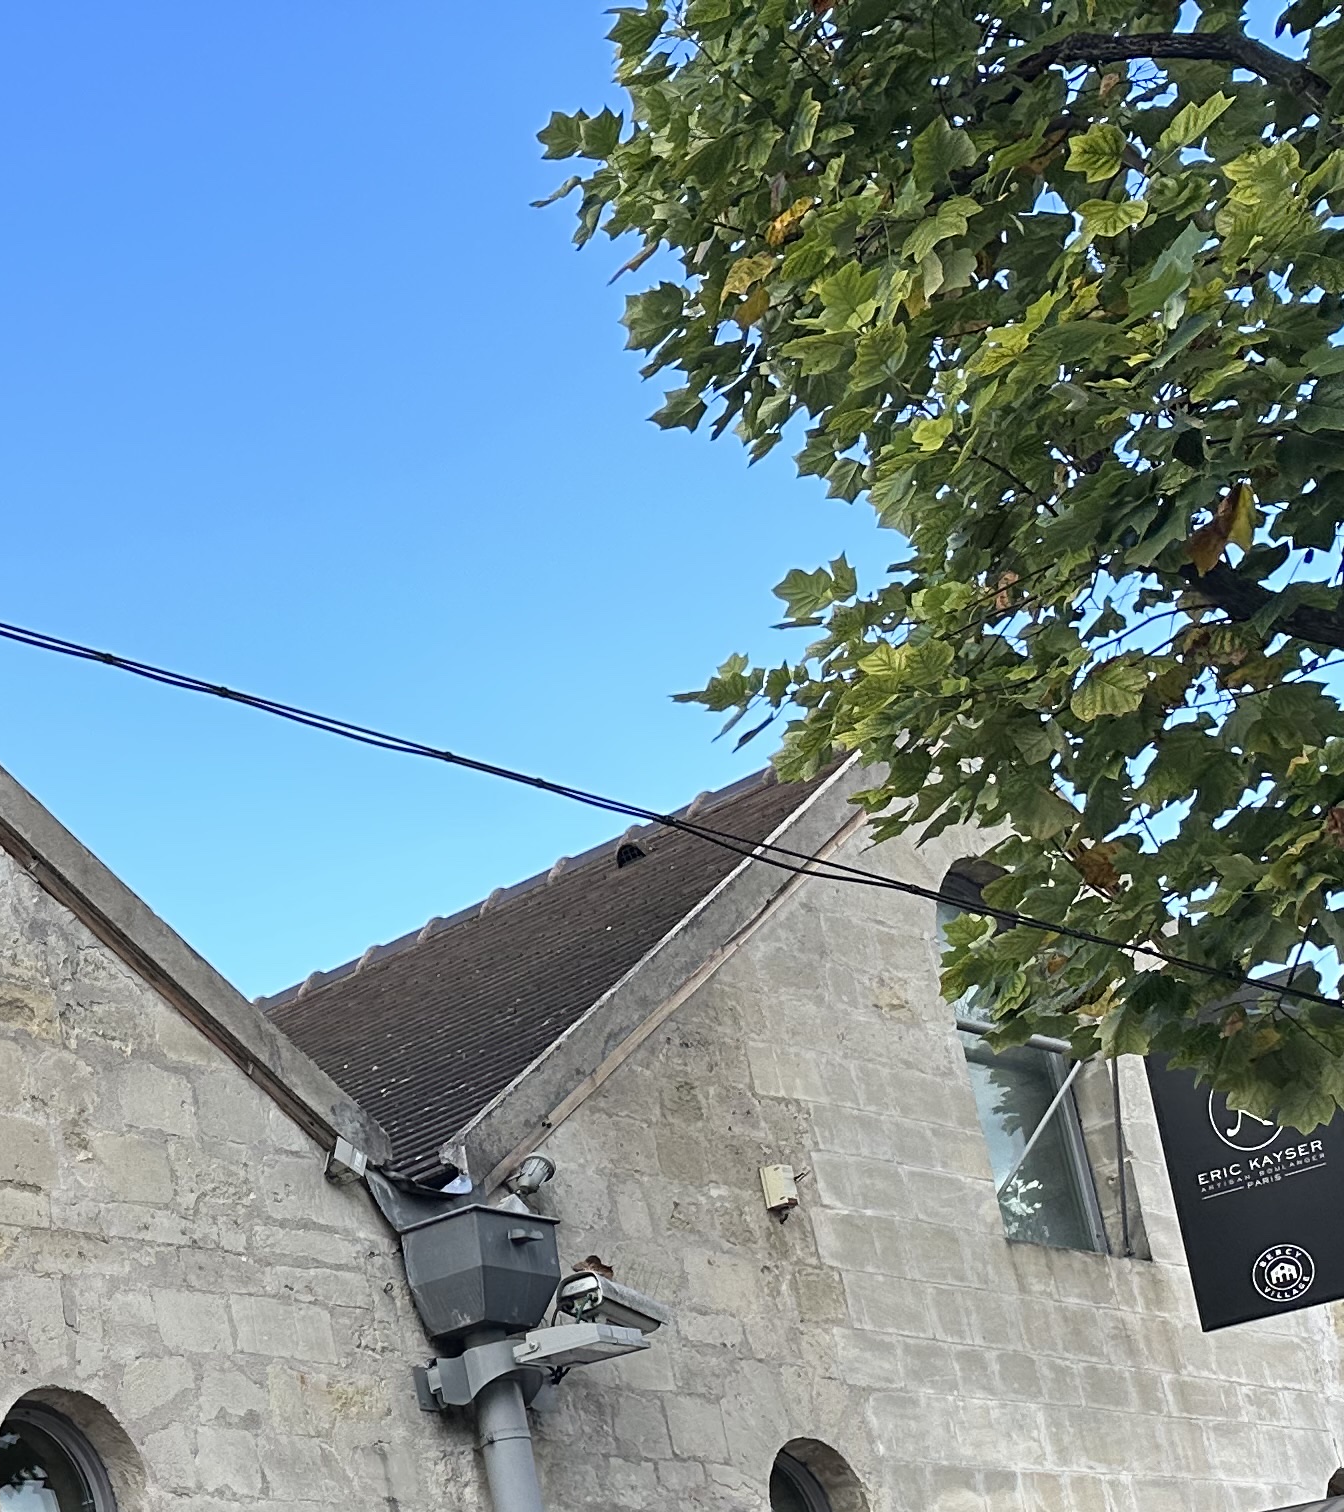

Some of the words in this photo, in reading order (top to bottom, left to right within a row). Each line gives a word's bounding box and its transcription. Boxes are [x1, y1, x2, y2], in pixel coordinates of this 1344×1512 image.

[1197, 1163, 1242, 1185] ERIC
[1248, 1139, 1323, 1171] KAYSER
[1200, 1174, 1251, 1193] ARTISAN
[1258, 1152, 1325, 1177] BOULANGER
[1247, 1173, 1282, 1188] PARIS
[1259, 1248, 1302, 1268] BERCY
[1263, 1275, 1310, 1299] VILLAGE
